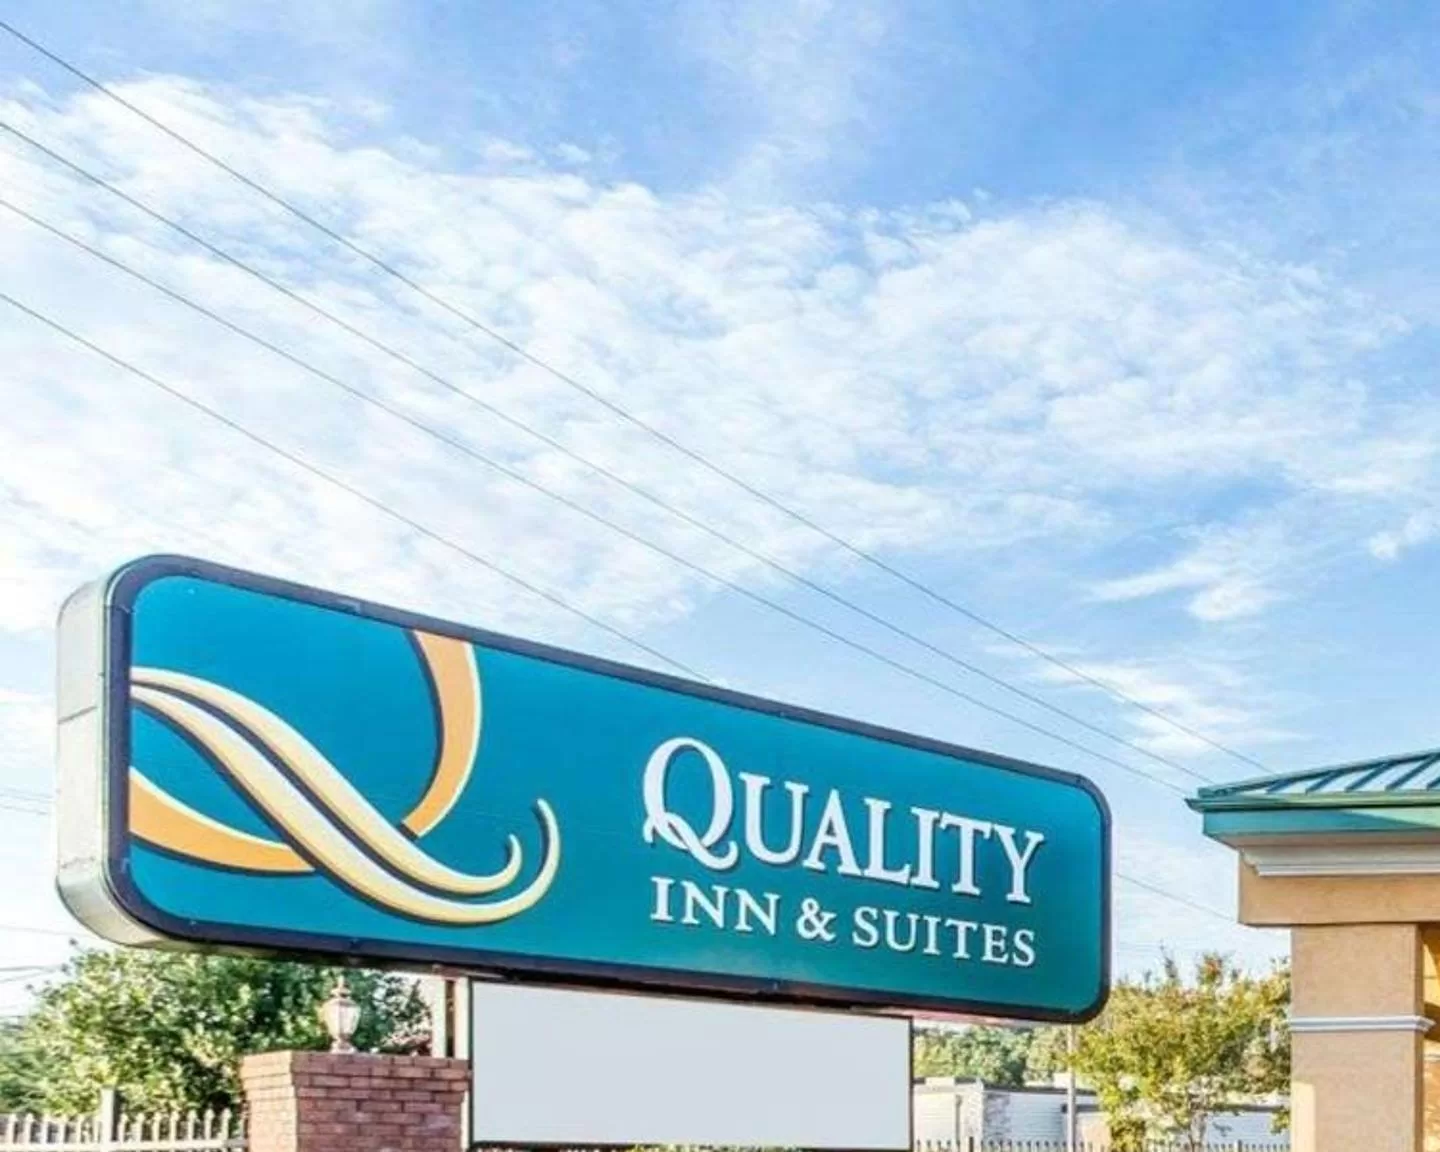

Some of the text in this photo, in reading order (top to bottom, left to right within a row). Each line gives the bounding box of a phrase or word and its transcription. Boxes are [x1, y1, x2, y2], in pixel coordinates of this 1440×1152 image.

[642, 736, 1045, 905] QUALITY
[651, 876, 1036, 968] INN & SUITES
